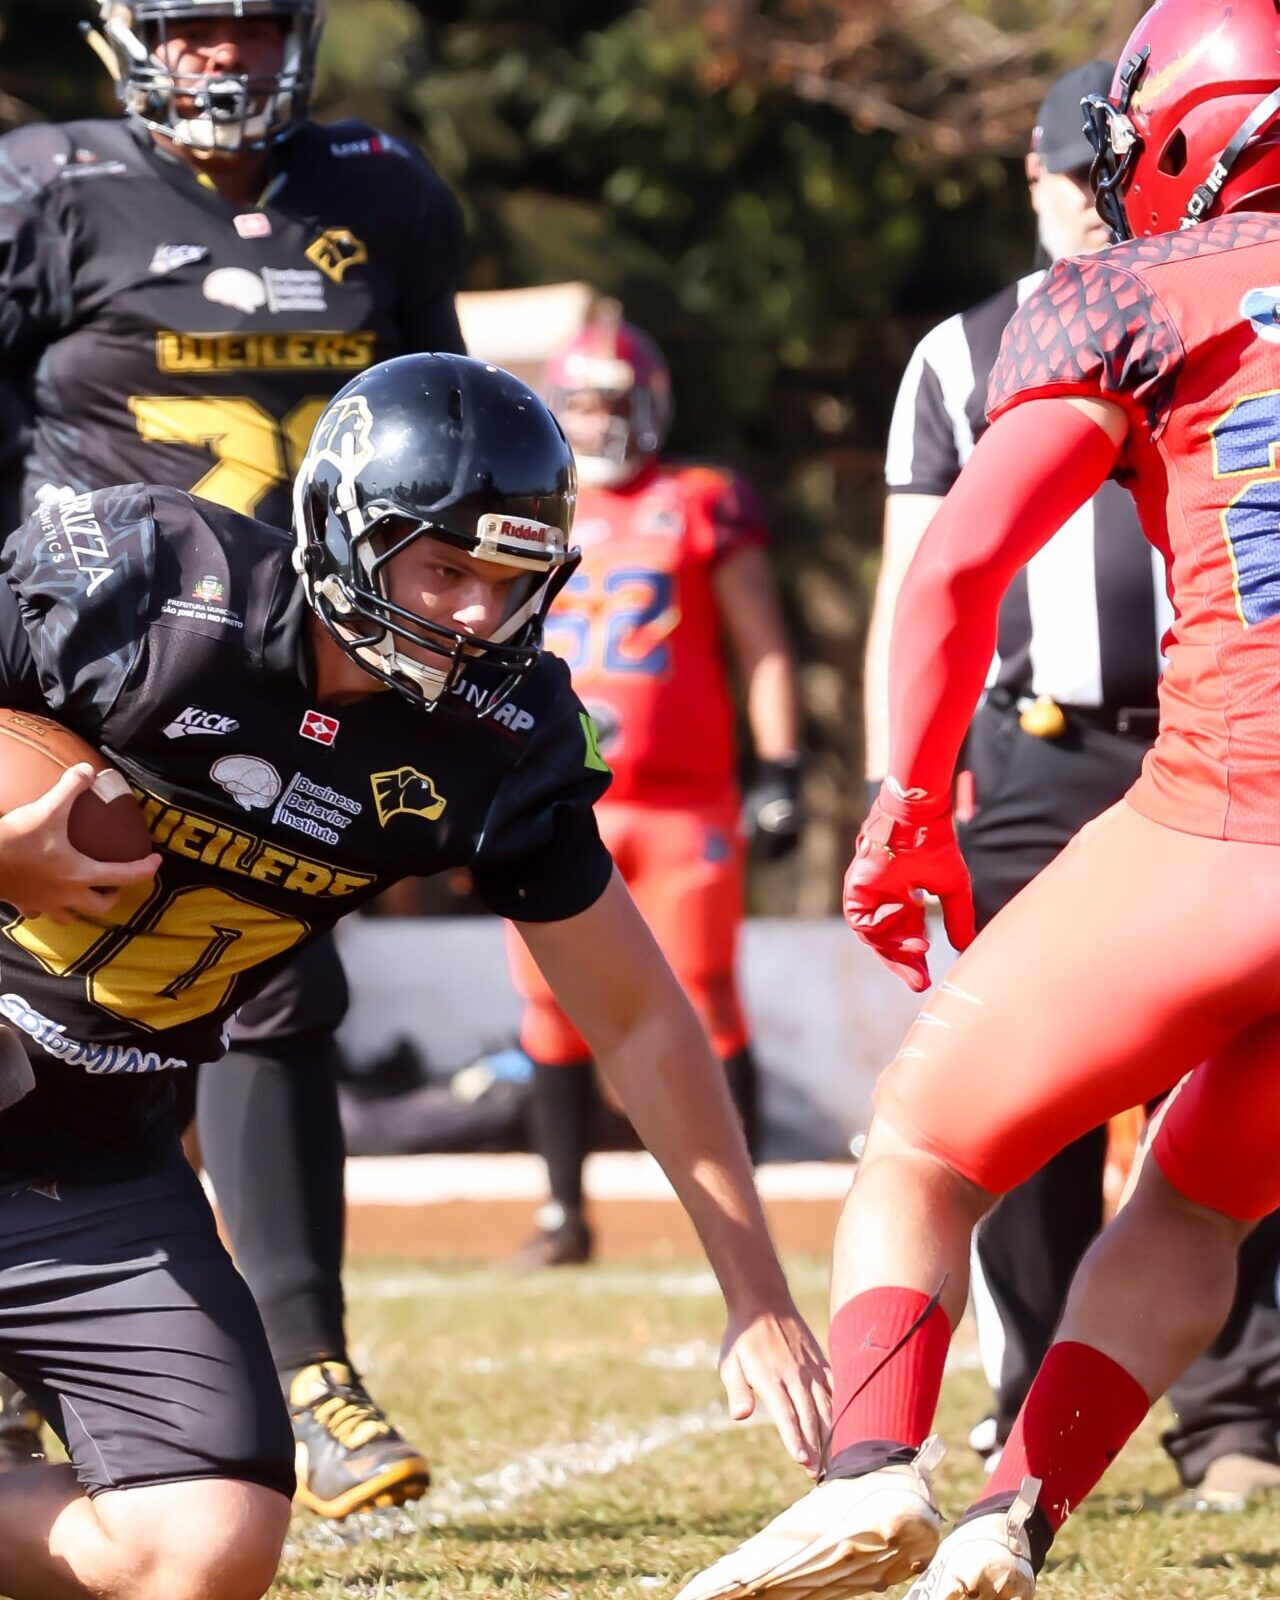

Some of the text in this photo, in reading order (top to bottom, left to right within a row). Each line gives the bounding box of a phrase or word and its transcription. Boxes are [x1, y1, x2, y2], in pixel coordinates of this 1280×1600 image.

[156, 330, 377, 374] WEILERS
[127, 395, 330, 519] 7
[500, 521, 546, 543] Riddell
[167, 598, 206, 611] PREFEITURA
[195, 611, 207, 619] DO
[221, 617, 244, 629] PRETO
[451, 679, 536, 732] UNRP
[287, 793, 352, 829] Behavior
[295, 776, 362, 815] Business
[279, 808, 340, 845] Institute
[2, 866, 312, 1033] 10
